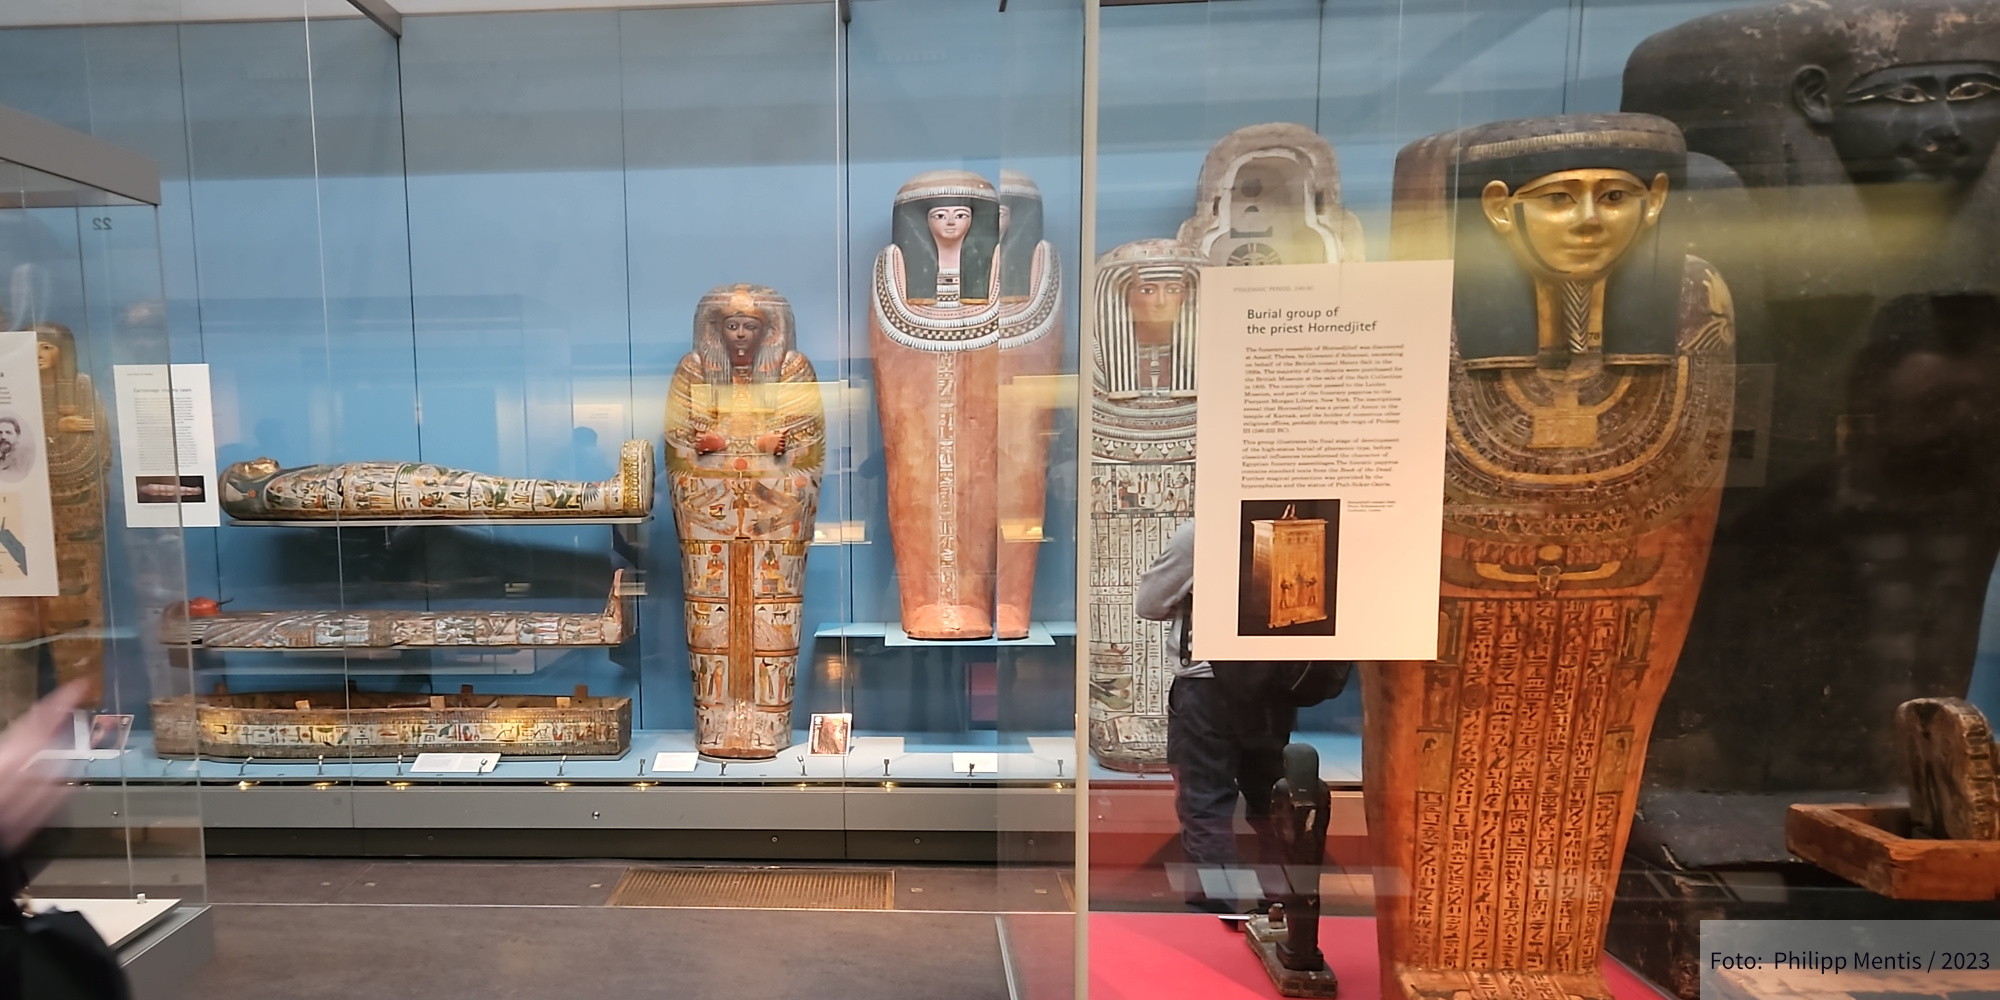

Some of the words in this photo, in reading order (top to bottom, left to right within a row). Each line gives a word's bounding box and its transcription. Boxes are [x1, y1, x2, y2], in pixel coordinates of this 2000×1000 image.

[1247, 308, 1282, 320] Burial
[1286, 310, 1322, 320] group
[1326, 306, 1340, 318] of
[1246, 324, 1266, 334] the
[1270, 324, 1304, 336] priest
[1308, 321, 1378, 334] Hornedjitef
